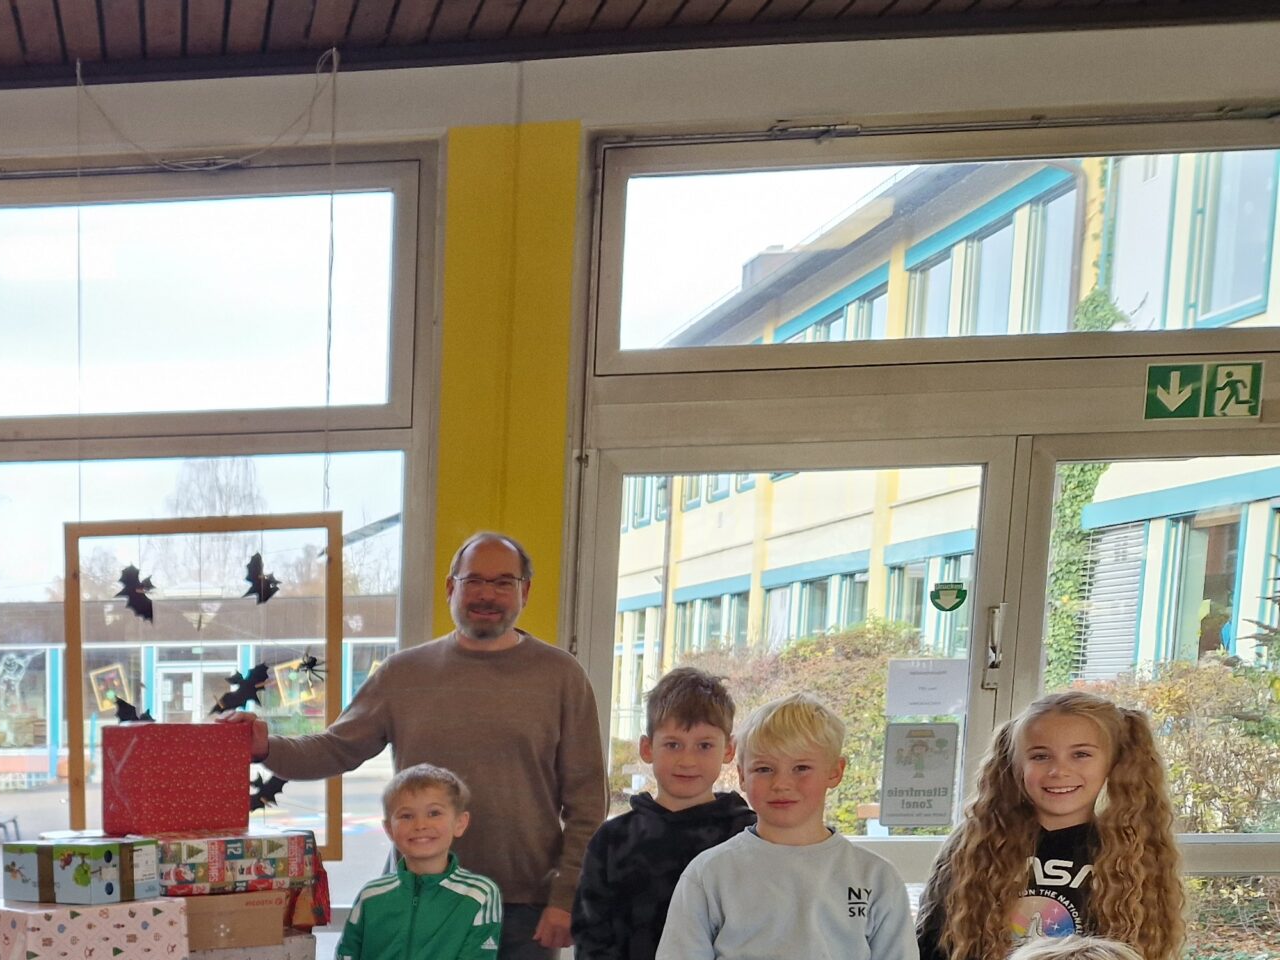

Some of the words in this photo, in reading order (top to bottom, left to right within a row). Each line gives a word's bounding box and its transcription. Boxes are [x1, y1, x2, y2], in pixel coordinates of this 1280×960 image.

[848, 887, 872, 900] NY
[1039, 888, 1058, 898] THE
[1057, 895, 1083, 935] NATIONAL
